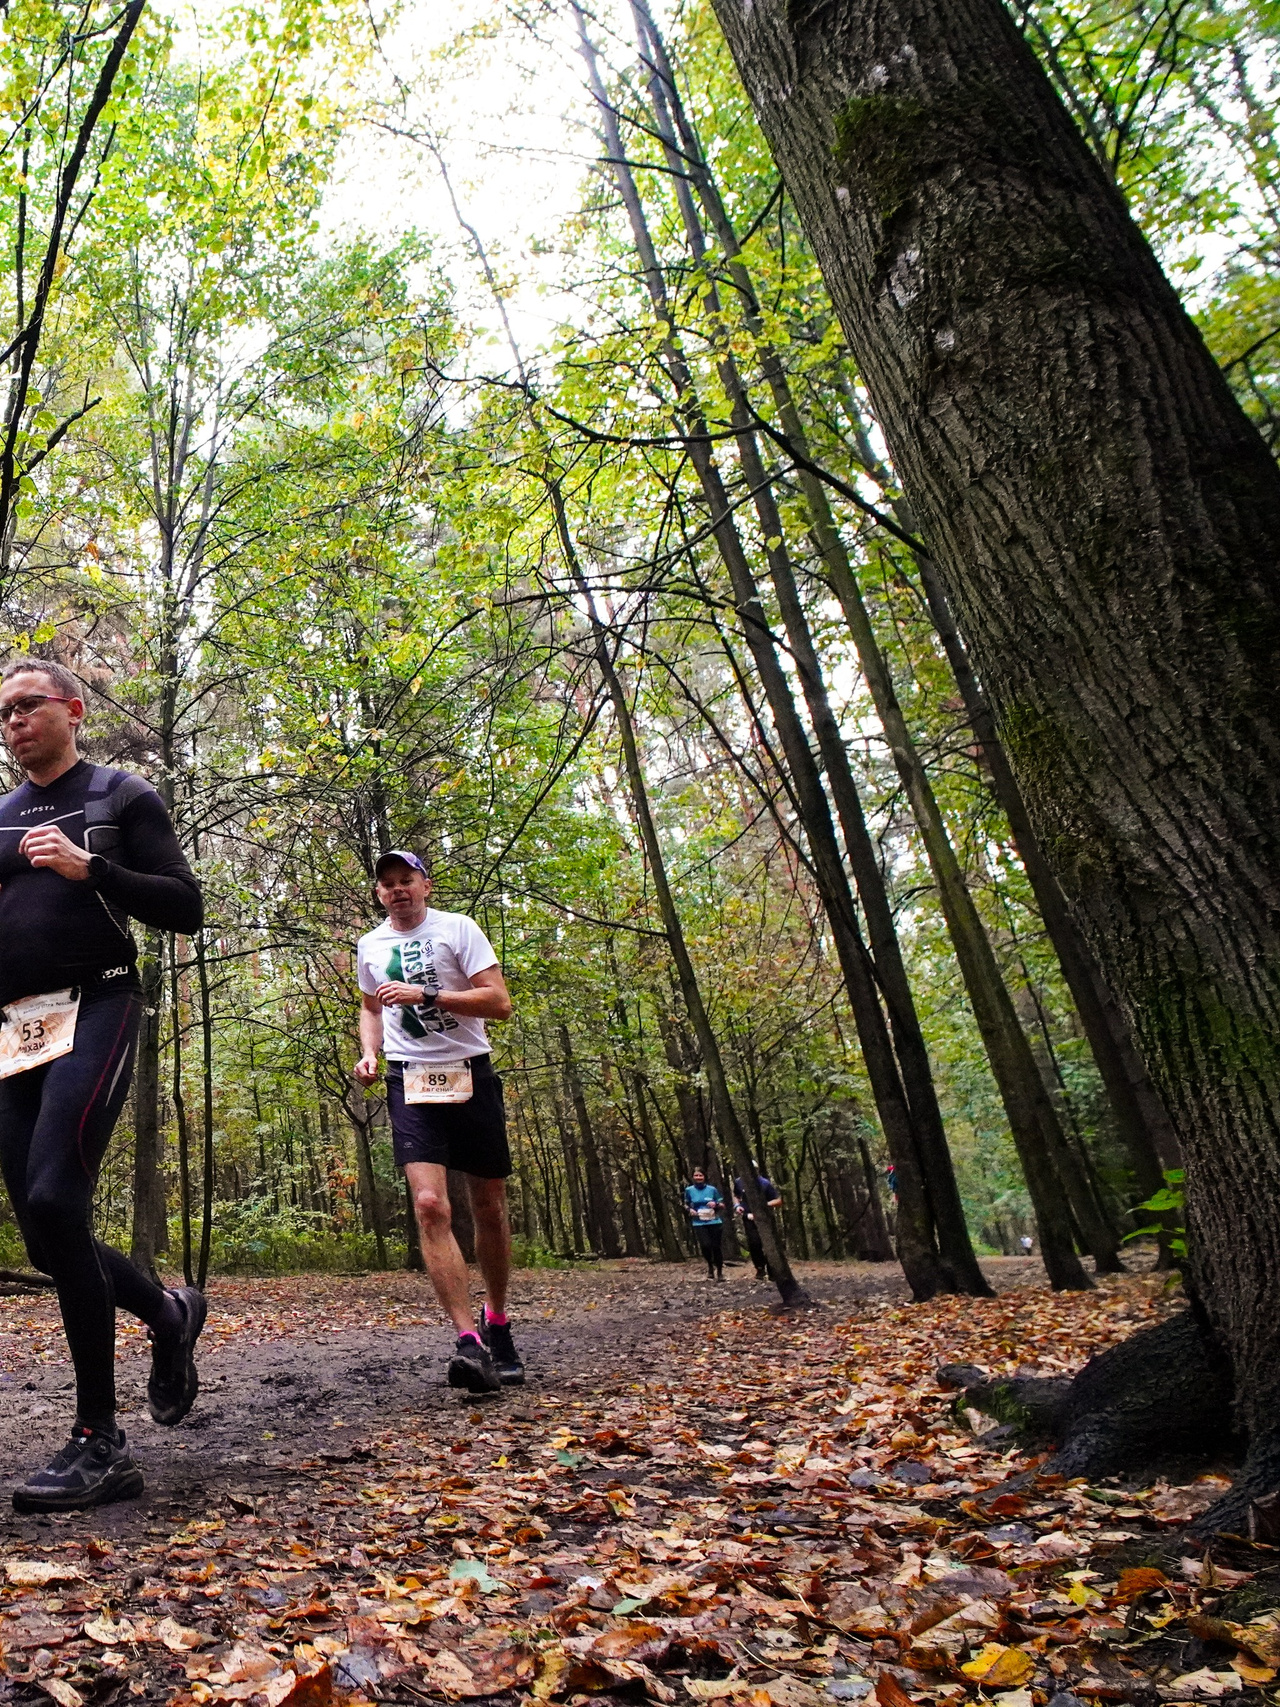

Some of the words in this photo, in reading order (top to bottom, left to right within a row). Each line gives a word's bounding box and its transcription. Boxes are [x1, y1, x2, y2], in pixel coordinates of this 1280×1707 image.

[19, 805, 55, 817] KIPSTA
[22, 1019, 45, 1042] 53
[428, 1073, 447, 1086] 89
